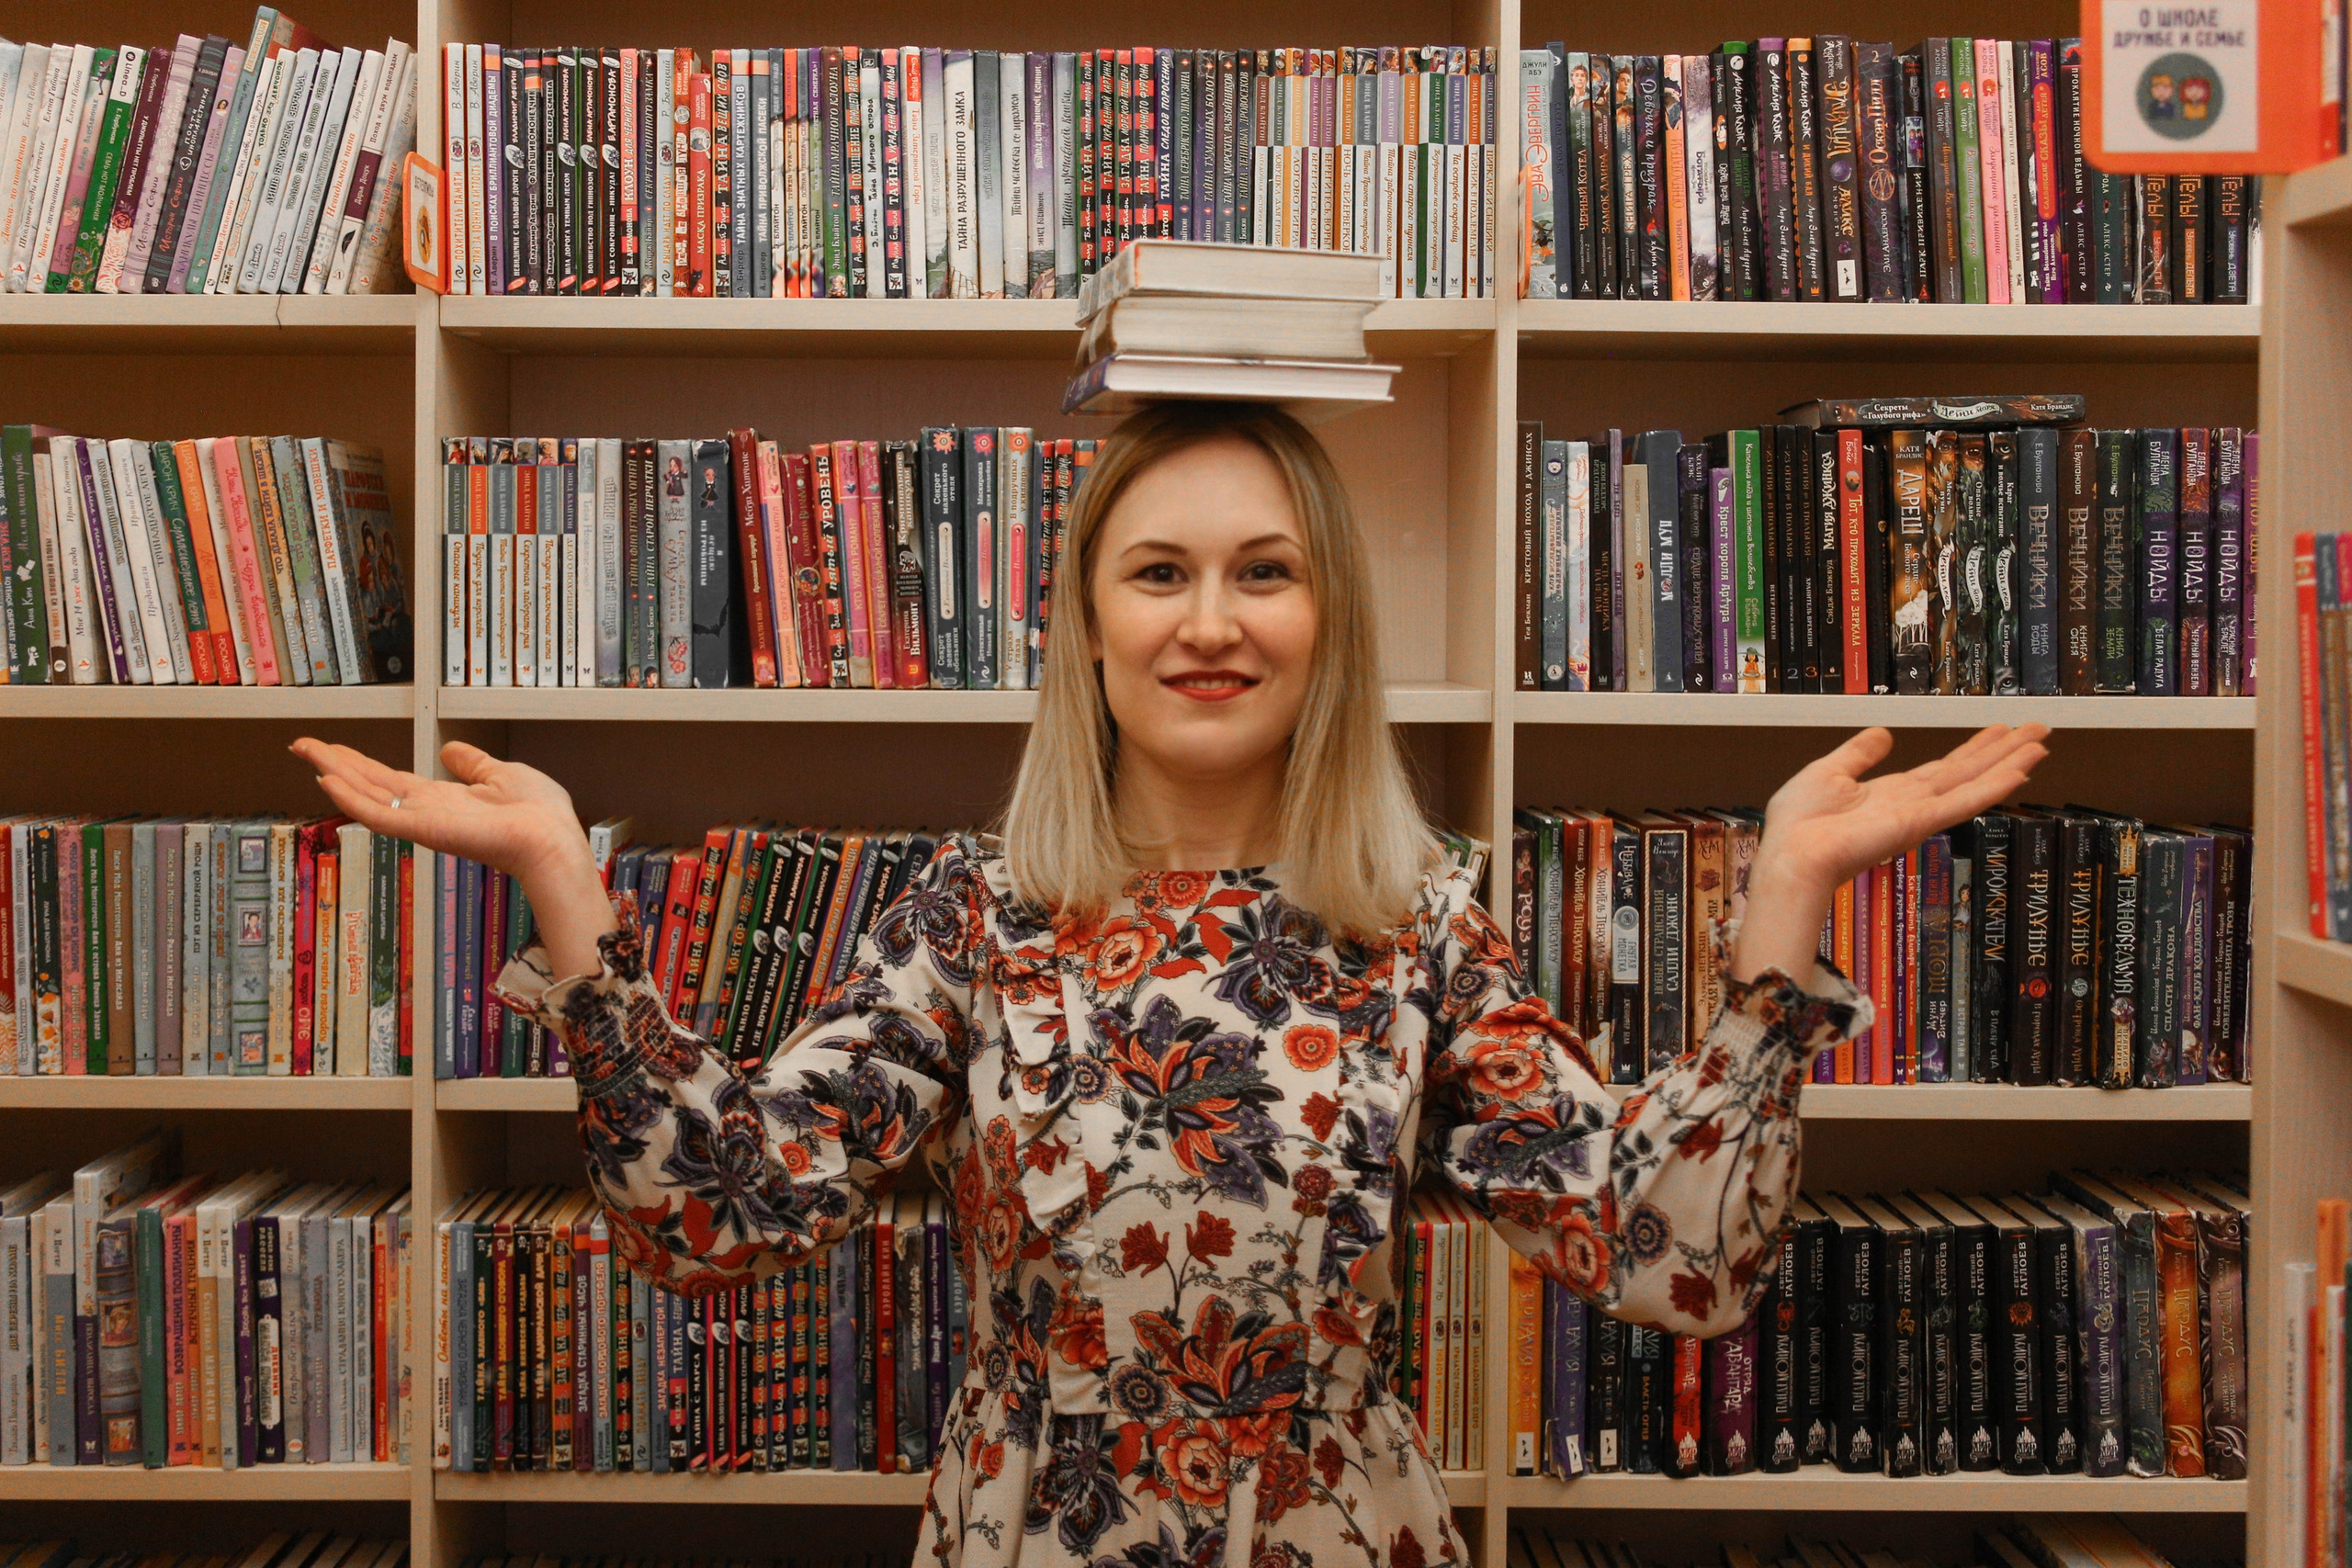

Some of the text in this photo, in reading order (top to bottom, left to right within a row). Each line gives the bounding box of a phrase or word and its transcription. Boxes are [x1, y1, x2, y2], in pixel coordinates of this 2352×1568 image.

[2139, 8, 2219, 28] О ШКОЛЕ
[2114, 32, 2245, 48] ДРУЖБЕ И СЕМЬЕ
[382, 54, 398, 91] водопадам
[378, 95, 390, 112] двум
[486, 75, 498, 117] ДИАДЕМЫ
[276, 120, 296, 160] МУЗЫКА
[369, 121, 383, 143] Поход
[622, 57, 634, 201] КЛОУН ДЛЯ ЧЕРНОЙ ПРИНЦЕССЫ
[828, 66, 840, 197] ТАЙНА МРАЧНОГО КЛОУНА
[1158, 56, 1170, 199] ТАЙНА СЛЕДОВ ПОРОСЕНКА
[1452, 104, 1460, 141] БЛАЙТОН
[1640, 79, 1658, 205] Девочка и призрак
[1869, 118, 1888, 164] Оскар
[2071, 68, 2083, 194] ПРОКЛЯТИЕ НОЧНОЙ ВЕДЬМЫ
[55, 138, 70, 175] взглядом
[272, 162, 284, 175] БЫ
[325, 132, 356, 218] Невидимый папа
[486, 120, 499, 191] БРИЛЛИАНТОВОЙ
[735, 85, 746, 244] ТАЙНА ЗНАТНЫХ КАРТЕЖНИКОВ
[955, 91, 967, 251] ТАЙНА РАЗРУШЕННОГО ЗАМКА
[1802, 153, 1813, 179] ДИКИЙ
[18, 141, 46, 248] Школьные годы недетские
[44, 176, 62, 225] застывшим
[266, 176, 280, 205] ЛИШЬ
[1450, 152, 1461, 243] На острове сокровищ
[1804, 182, 1813, 197] БАЛ
[176, 153, 215, 274] КАНИКУЛЫ ПРИНЦЕССЫ
[452, 171, 465, 260] ПОХИТИТЕЛЬ ПАМЯТИ
[488, 195, 499, 232] ПОИСКАХ
[696, 169, 706, 254] МАСКА ПРИЗРАКА
[38, 234, 51, 259] Чайка
[831, 214, 841, 269] Энид Блайтон
[1804, 247, 1818, 278] Андерсон
[2076, 221, 2086, 276] АЛЕКС АСТЕР
[1651, 269, 1659, 297] АЛКАФ
[1862, 412, 1926, 421] «Голубого рифа»
[1874, 403, 1907, 413] Секреты
[2047, 402, 2073, 412] Брандис
[309, 448, 337, 569] ПАРФЕТКИ И МОВЕШКИ
[820, 456, 834, 528] УРОВЕНЬ
[1524, 493, 1532, 525] ПОХОД
[1897, 469, 1923, 535] ДАРЕШ
[69, 547, 79, 566] года
[849, 518, 864, 610] КТО УКРАЛ РОМАН?
[1719, 506, 1731, 622] Крест короля Артура
[1904, 543, 1912, 575] Белого
[1912, 553, 1920, 584] Сердце
[74, 605, 83, 615] 14
[76, 617, 85, 637] Мне
[2031, 625, 2040, 655] ВОДЫ
[2040, 623, 2048, 656] КНИГА
[192, 870, 201, 922] СЕРЕБРЯНОЙ
[686, 847, 719, 984] ТАЙНА СТАРОГО КЛАДБИЩА
[194, 925, 200, 935] ИЗ
[1667, 893, 1679, 991] САЛЛИ ДЖОНС
[1616, 938, 1627, 973] МОНЕТКА
[1627, 941, 1636, 968] ГНУТАЯ
[319, 912, 330, 1042] Королева кривых зеркал
[1975, 1243, 1984, 1295] ГАГЛОЕВ
[172, 1225, 184, 1374] ВОЗВРАЩЕНИЕ ПОЛЛИАННЫ
[437, 1233, 450, 1363] Ответы на засыпку
[577, 1275, 587, 1412] ЗАГАДКА СТАРИННЫХ ЧАСОВ
[1743, 1357, 1752, 1393] ОТРЯД
